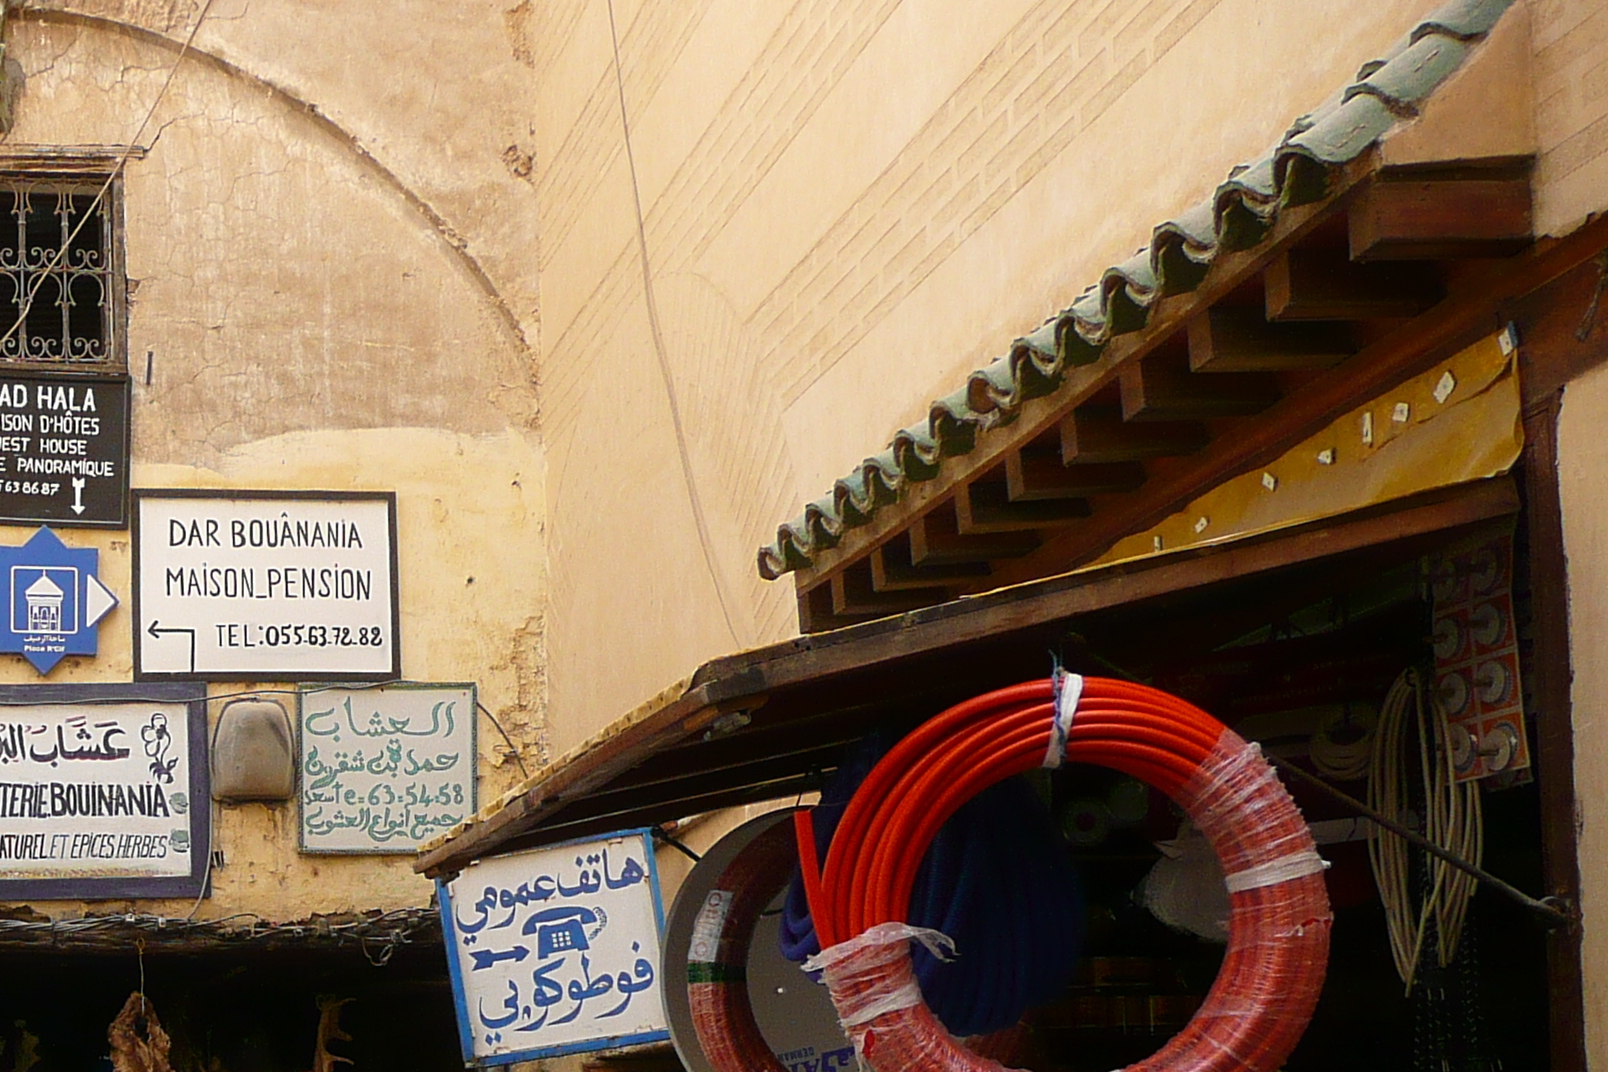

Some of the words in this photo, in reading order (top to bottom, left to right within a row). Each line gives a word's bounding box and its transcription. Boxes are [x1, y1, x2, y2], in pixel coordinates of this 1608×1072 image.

[37, 386, 96, 412] HALA
[40, 438, 88, 456] HOUSE
[17, 457, 114, 478] PANORAMIQUE
[169, 518, 221, 547] DAR
[304, 695, 457, 742] العشاب
[116, 834, 168, 859] HERBES
[557, 848, 644, 897] هاتف
[455, 875, 556, 946] عمومي
